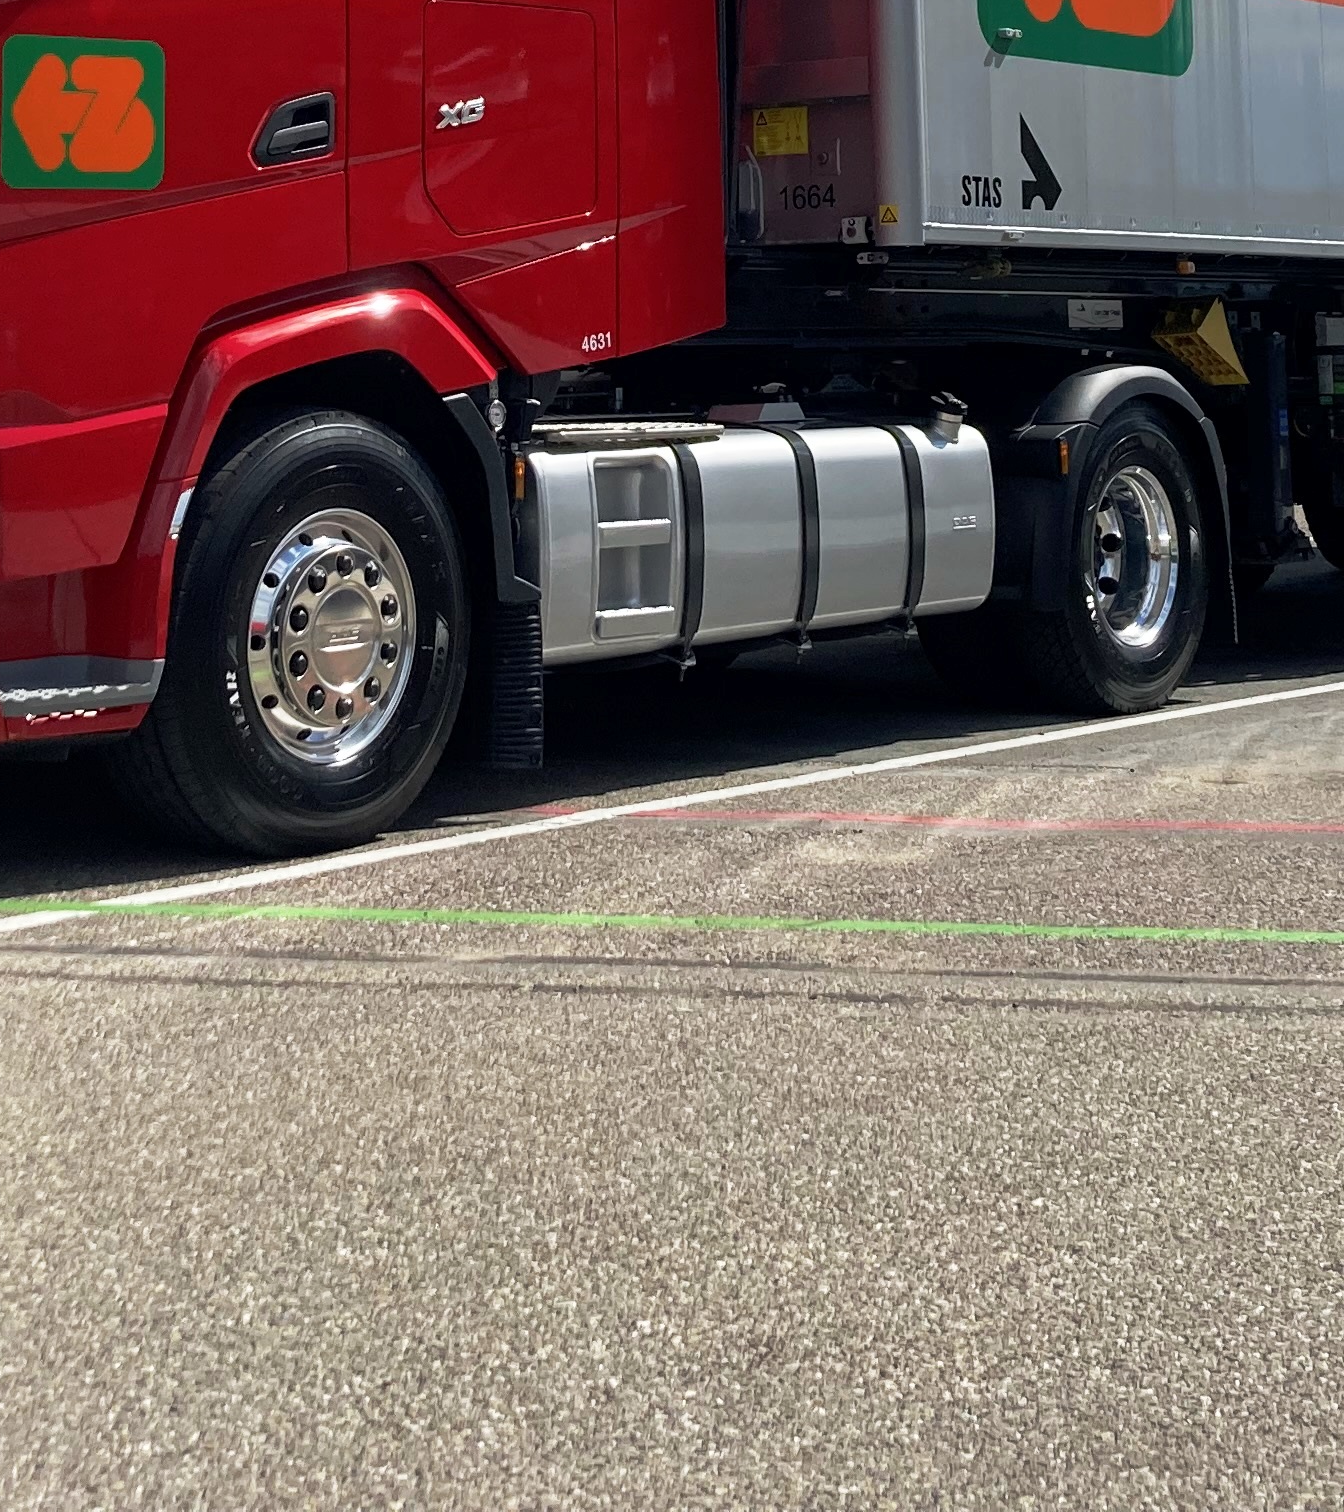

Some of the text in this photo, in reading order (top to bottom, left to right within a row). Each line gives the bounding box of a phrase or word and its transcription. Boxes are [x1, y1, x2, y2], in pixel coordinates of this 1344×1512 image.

[435, 95, 485, 129] XG
[779, 183, 836, 210] 1664
[962, 175, 1002, 208] STAS
[581, 331, 612, 353] 4631
